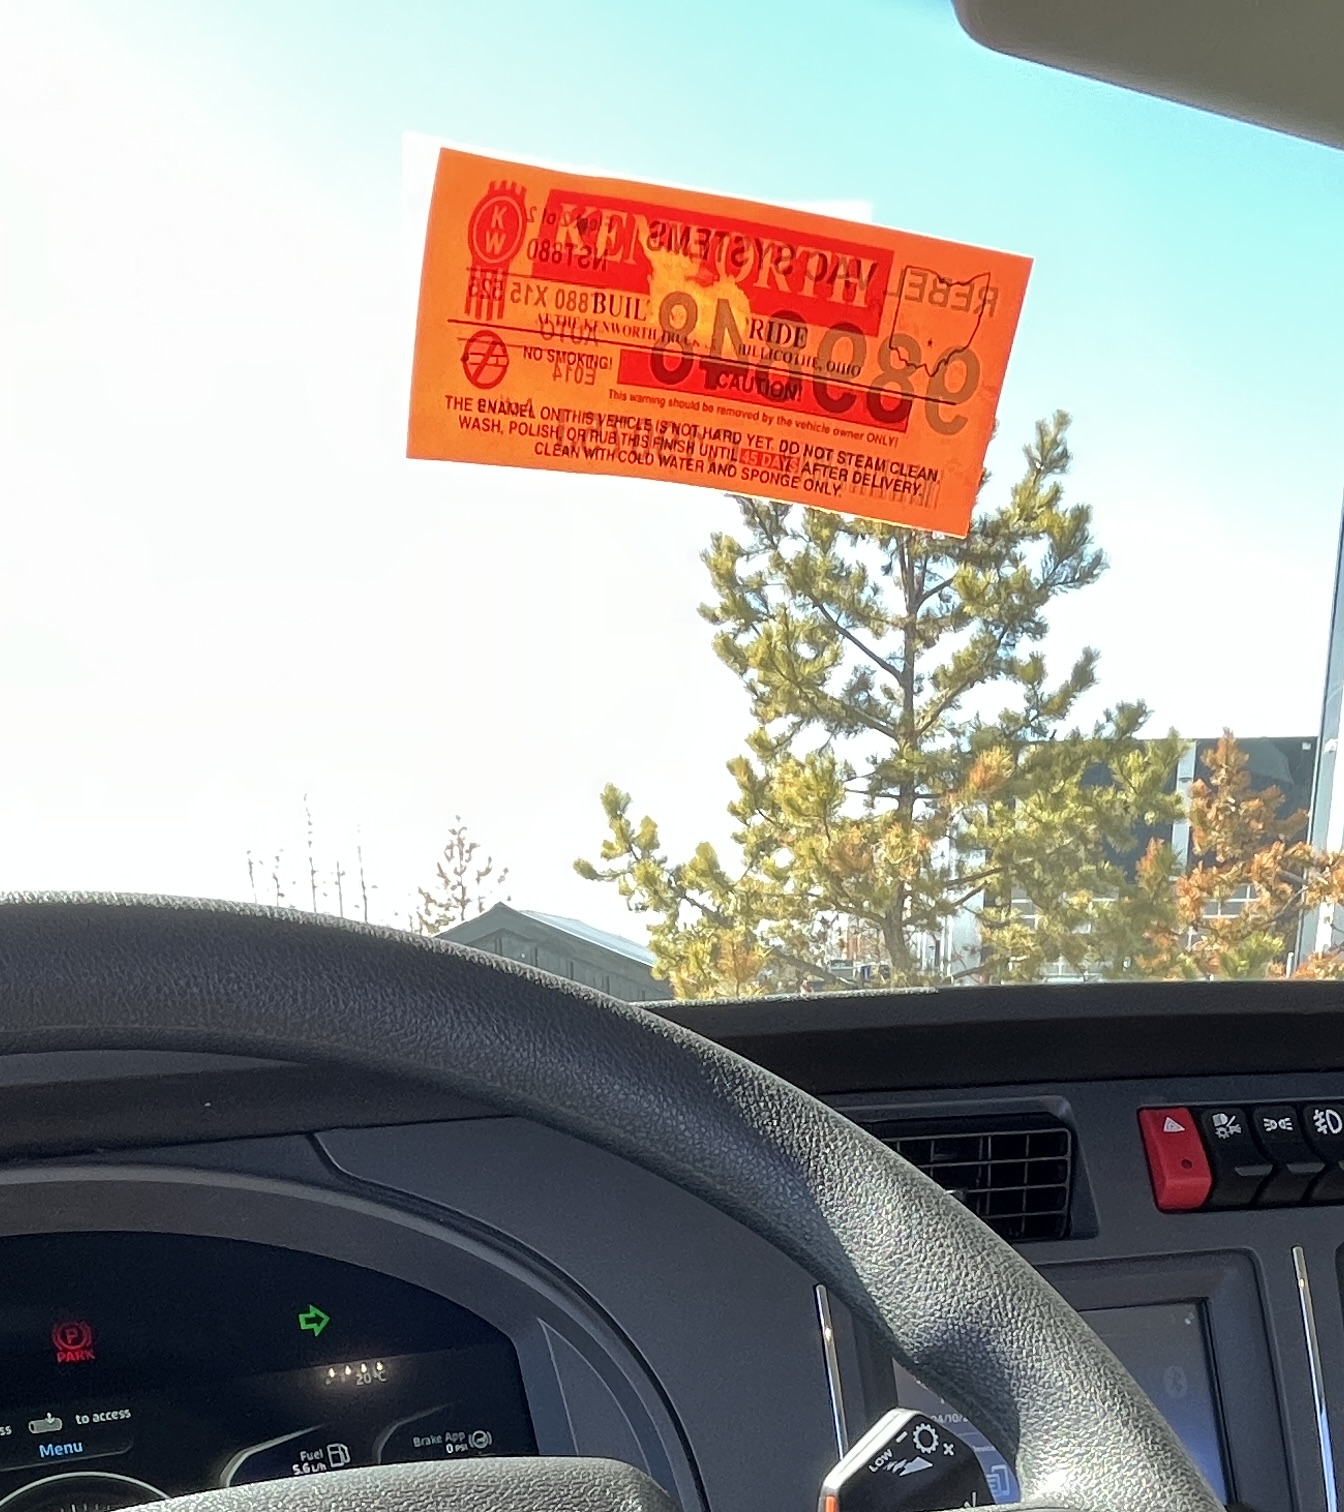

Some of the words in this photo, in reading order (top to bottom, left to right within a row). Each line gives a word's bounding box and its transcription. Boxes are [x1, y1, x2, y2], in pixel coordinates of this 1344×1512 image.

[555, 202, 879, 308] KENORTH
[592, 290, 651, 323] BUIL
[745, 315, 809, 349] RIDE
[522, 345, 544, 363] NO
[545, 347, 613, 371] SMOKING!
[737, 343, 822, 373] HILLICOTHE,
[715, 371, 803, 402] CAUTION!
[608, 388, 627, 403] This
[629, 392, 666, 409] warning
[667, 395, 700, 412] should
[702, 401, 715, 415] be
[716, 405, 760, 422] removed
[761, 411, 774, 426] by
[776, 414, 793, 428] the
[794, 418, 831, 436] vehicle
[832, 426, 864, 441] owner
[866, 431, 900, 450] ONLY!
[444, 394, 474, 413] THE
[539, 405, 560, 422] ON
[560, 407, 595, 426] THIS
[597, 412, 652, 433] VEHICLE
[654, 418, 669, 434] IS
[670, 420, 701, 438] NOT
[702, 425, 742, 445] HARD
[745, 433, 774, 451] YET.
[778, 438, 800, 455] DO
[802, 442, 834, 462] NOT
[836, 450, 889, 472] STEAM
[889, 460, 942, 485] CLEAN.
[457, 414, 505, 435] WASH,
[508, 419, 564, 440] POLISH,
[565, 426, 588, 443] OR
[588, 428, 617, 445] RUB
[620, 432, 649, 449] THIS
[651, 435, 696, 457] FINISH
[699, 445, 738, 463] UNTIL
[741, 450, 759, 466] 45
[801, 460, 848, 482] AFTER
[851, 468, 924, 497] DELIVERY.
[533, 441, 580, 460] CLEAN
[583, 447, 614, 462] WITH
[618, 449, 654, 466] COLD
[657, 454, 705, 474] WATER
[707, 461, 738, 478] AND
[740, 466, 801, 489] SPONGE
[803, 477, 843, 499] ONLY.
[56, 1349, 97, 1364] PARK
[75, 1414, 90, 1426] to
[91, 1408, 132, 1424] access
[38, 1441, 84, 1459] Menu
[412, 1433, 444, 1449] Brake
[444, 1430, 467, 1444] App
[299, 1448, 324, 1463] Fuel
[868, 1447, 893, 1473] LOW
